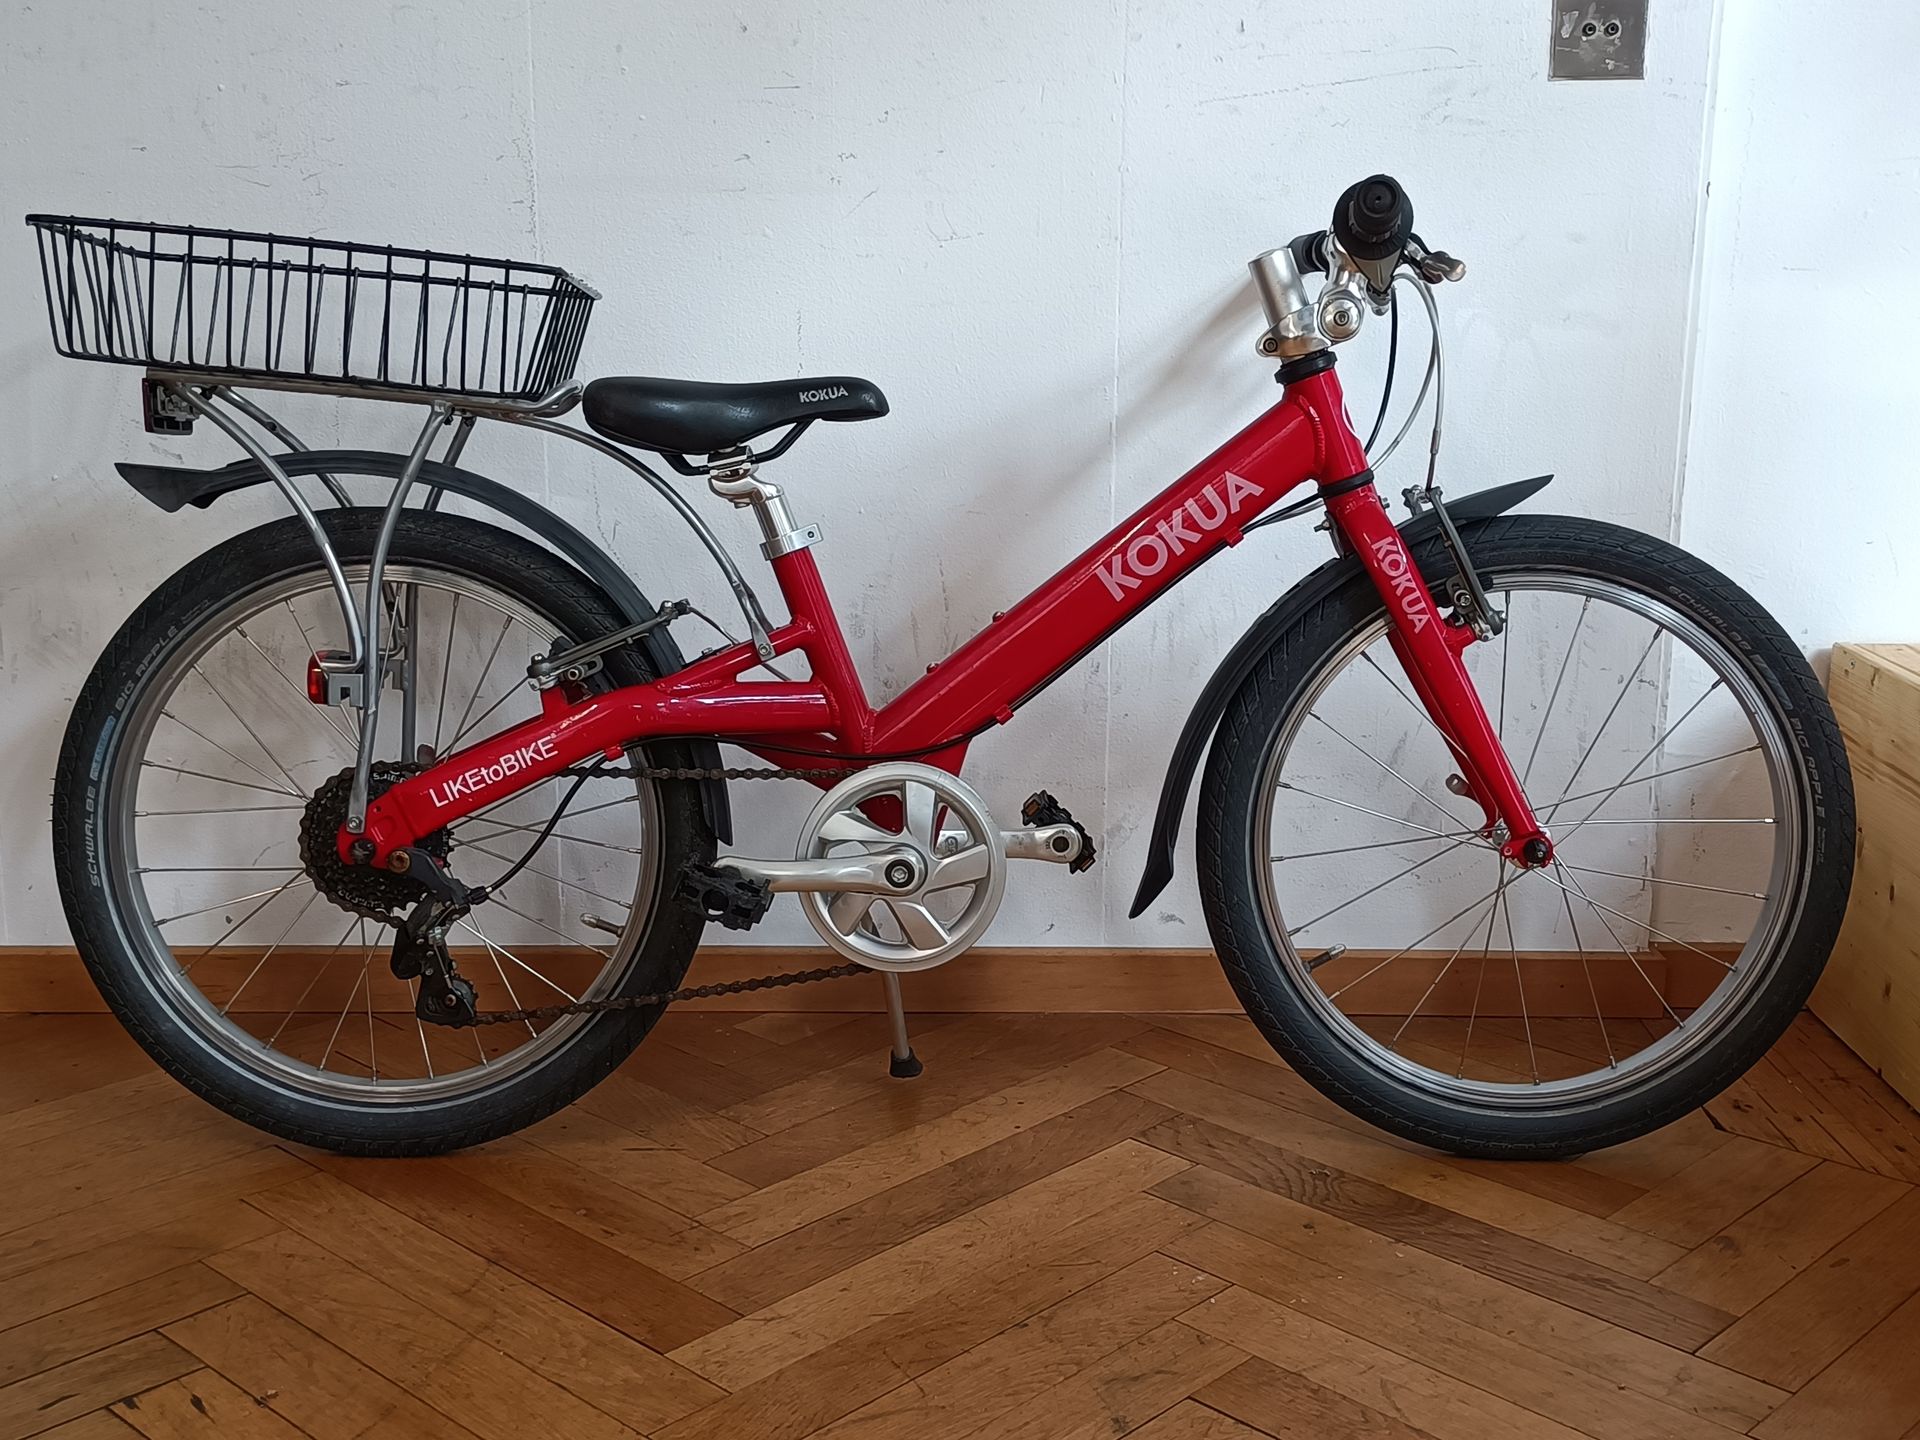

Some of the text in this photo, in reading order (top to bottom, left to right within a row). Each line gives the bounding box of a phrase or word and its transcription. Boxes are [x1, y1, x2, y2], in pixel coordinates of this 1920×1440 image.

[799, 386, 848, 403] KOKUA
[1095, 470, 1265, 602] KOKUA
[1371, 535, 1430, 634] KOKUA
[1667, 585, 1752, 650] SCHWALBE
[84, 625, 179, 888] SCHWALBE BIG APPLE
[429, 735, 558, 808] LIKEtoBIKE
